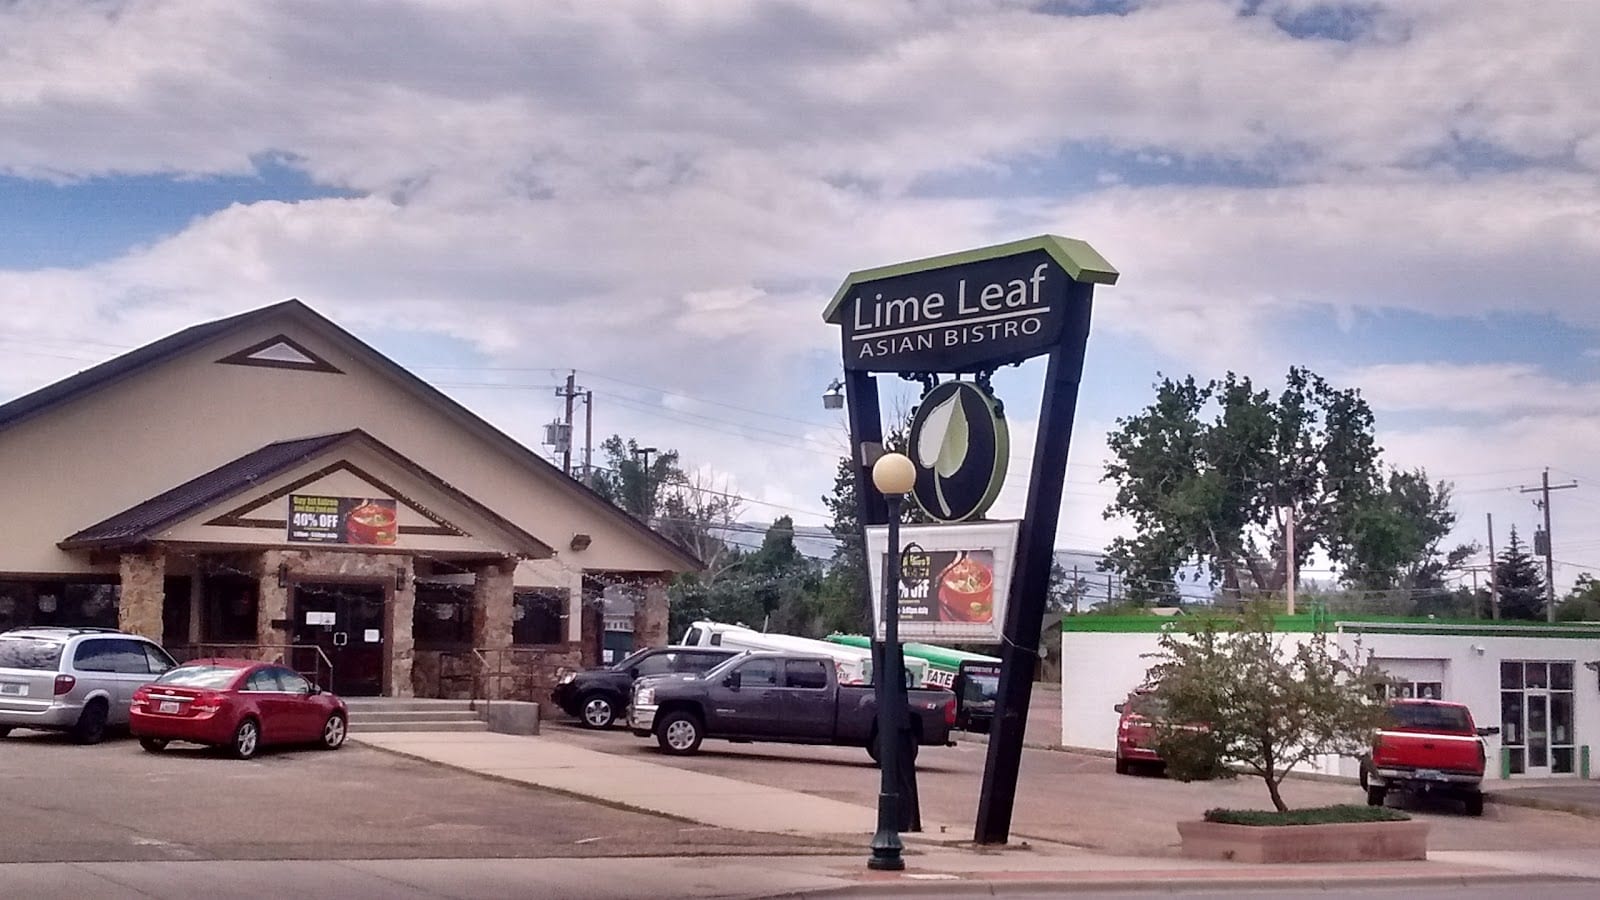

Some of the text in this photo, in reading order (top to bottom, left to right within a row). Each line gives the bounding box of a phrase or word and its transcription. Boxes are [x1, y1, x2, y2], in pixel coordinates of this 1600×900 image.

[854, 263, 1048, 331] Lime Leaf
[859, 317, 1041, 358] ASIAN BISTRO
[293, 513, 338, 528] 40% OFF
